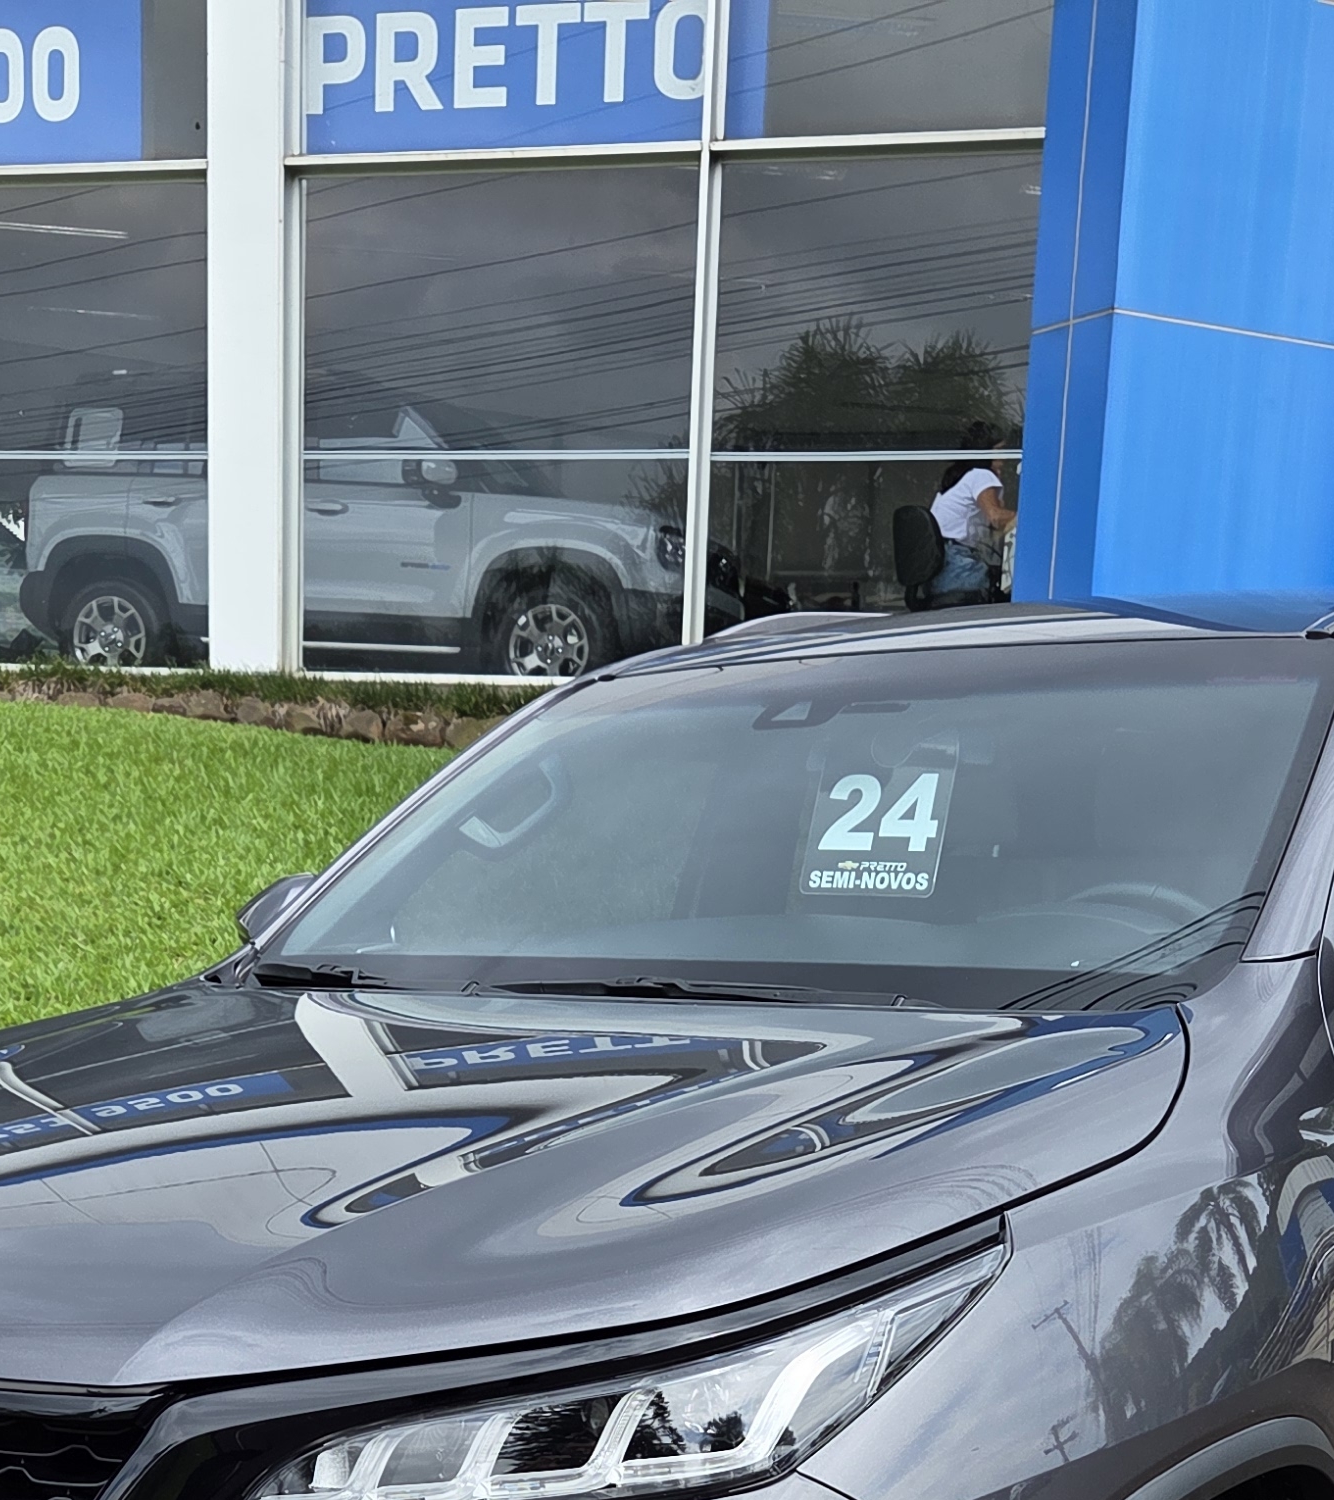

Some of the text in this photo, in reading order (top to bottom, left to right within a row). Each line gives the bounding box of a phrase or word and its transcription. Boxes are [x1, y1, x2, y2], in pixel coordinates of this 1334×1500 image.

[306, 0, 707, 115] PRETTO
[818, 773, 939, 852] 24
[809, 870, 929, 890] SEMI-NOVOS
[859, 861, 907, 871] PRETTO
